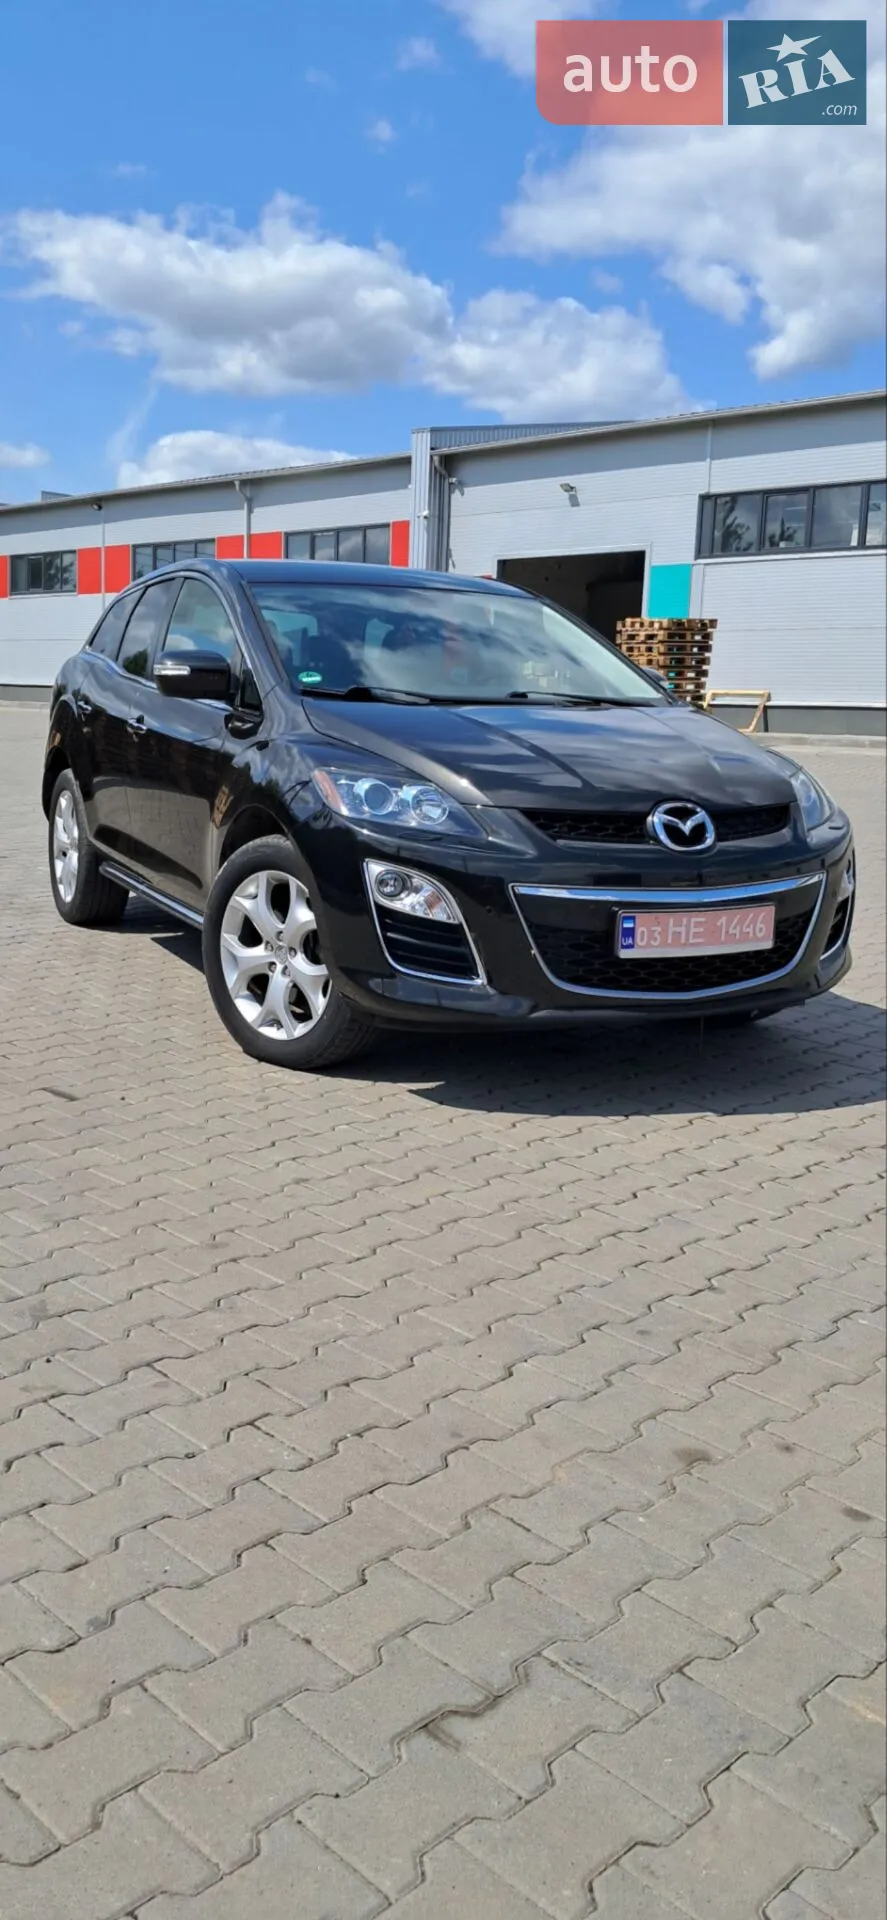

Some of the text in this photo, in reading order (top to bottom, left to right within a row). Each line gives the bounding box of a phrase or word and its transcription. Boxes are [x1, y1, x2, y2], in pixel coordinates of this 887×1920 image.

[636, 912, 766, 946] 03 HE 1446
[622, 937, 634, 946] UA
